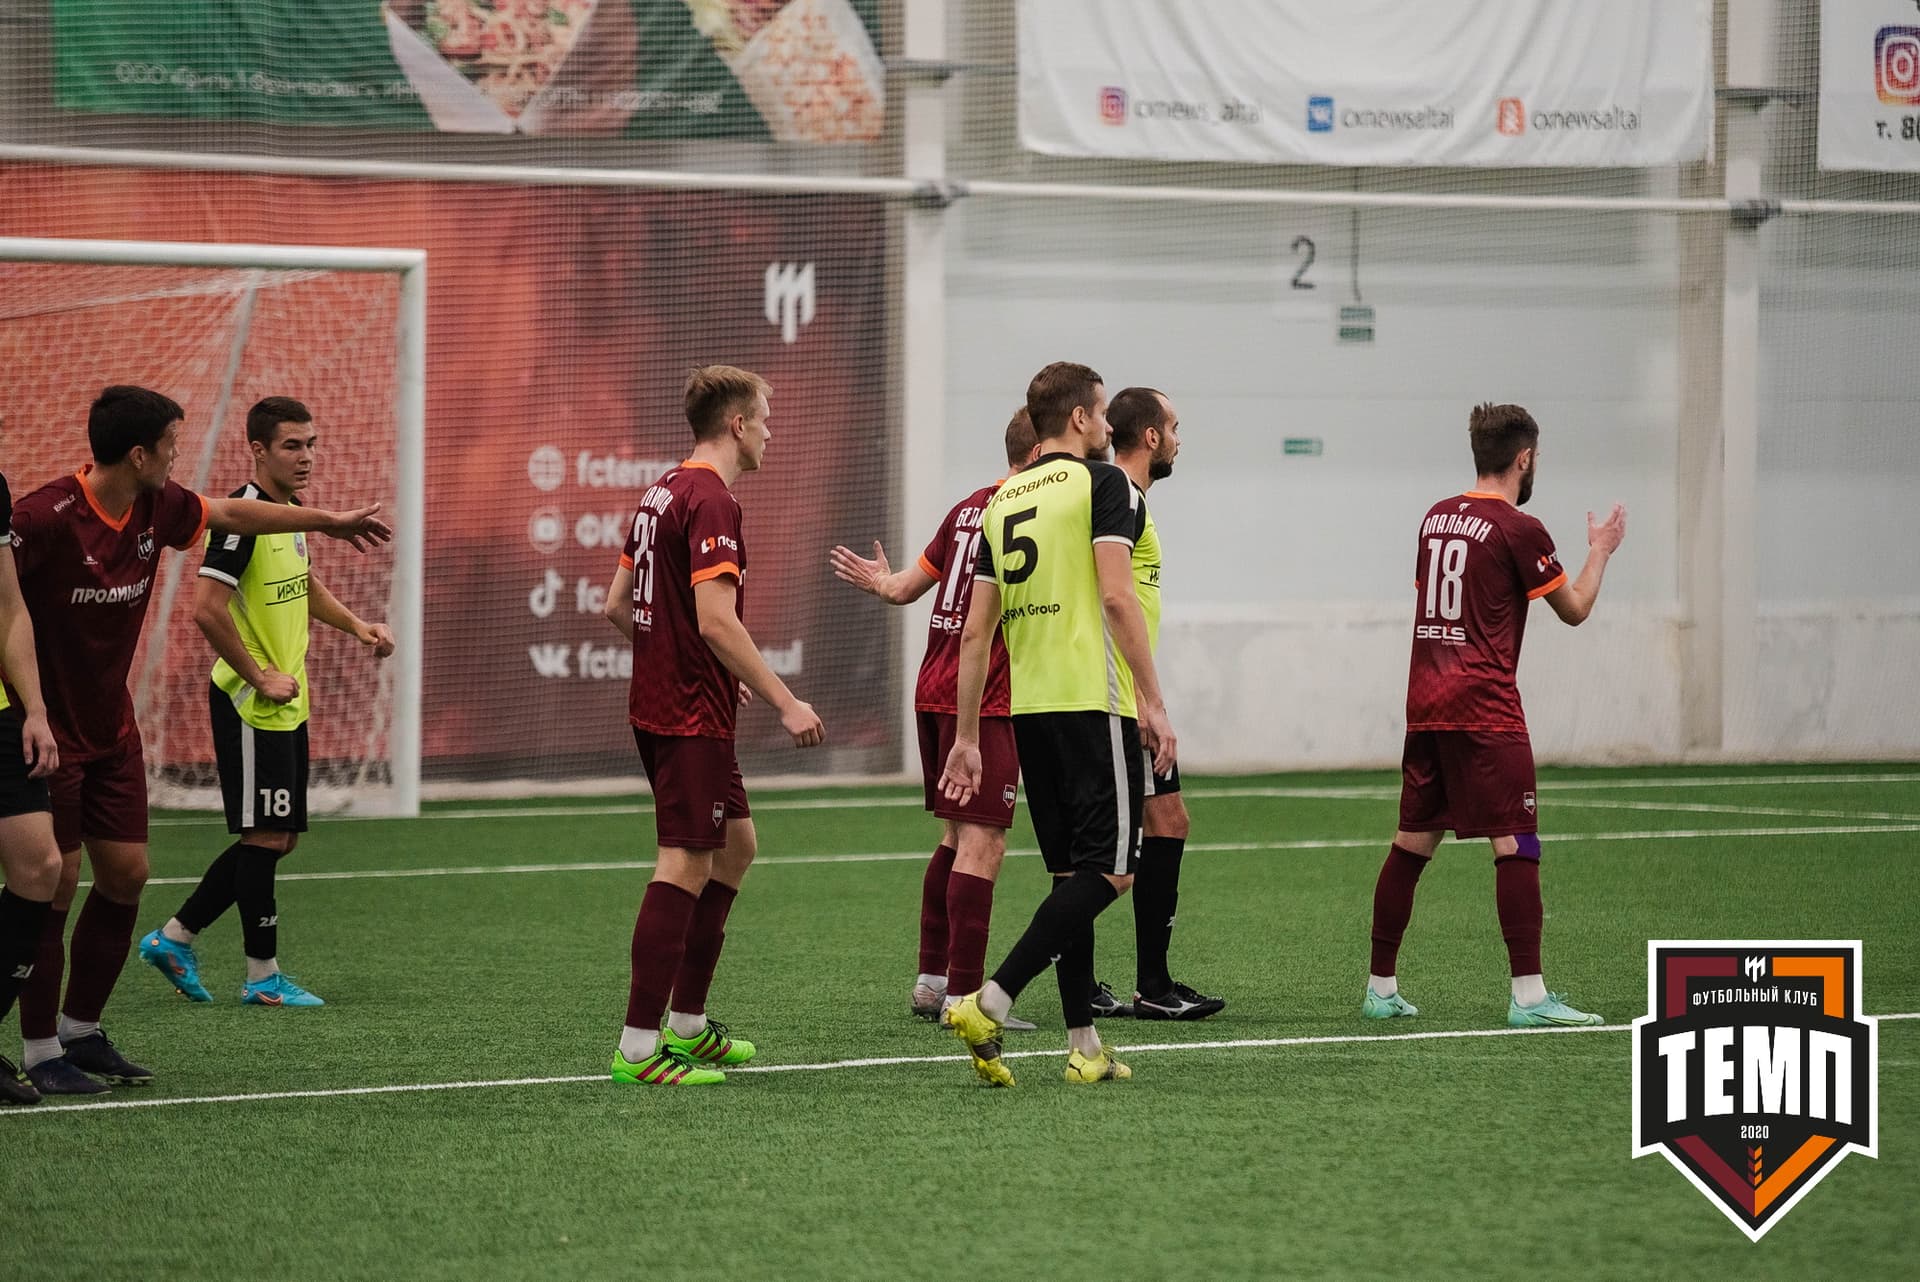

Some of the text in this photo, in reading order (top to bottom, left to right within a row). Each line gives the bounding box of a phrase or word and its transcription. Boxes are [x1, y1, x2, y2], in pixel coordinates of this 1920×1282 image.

[1290, 236, 1316, 290] 2
[1003, 506, 1038, 584] 5
[1426, 539, 1468, 620] 18
[1027, 603, 1061, 616] Group
[1417, 625, 1466, 641] SELS
[259, 788, 291, 817] 18
